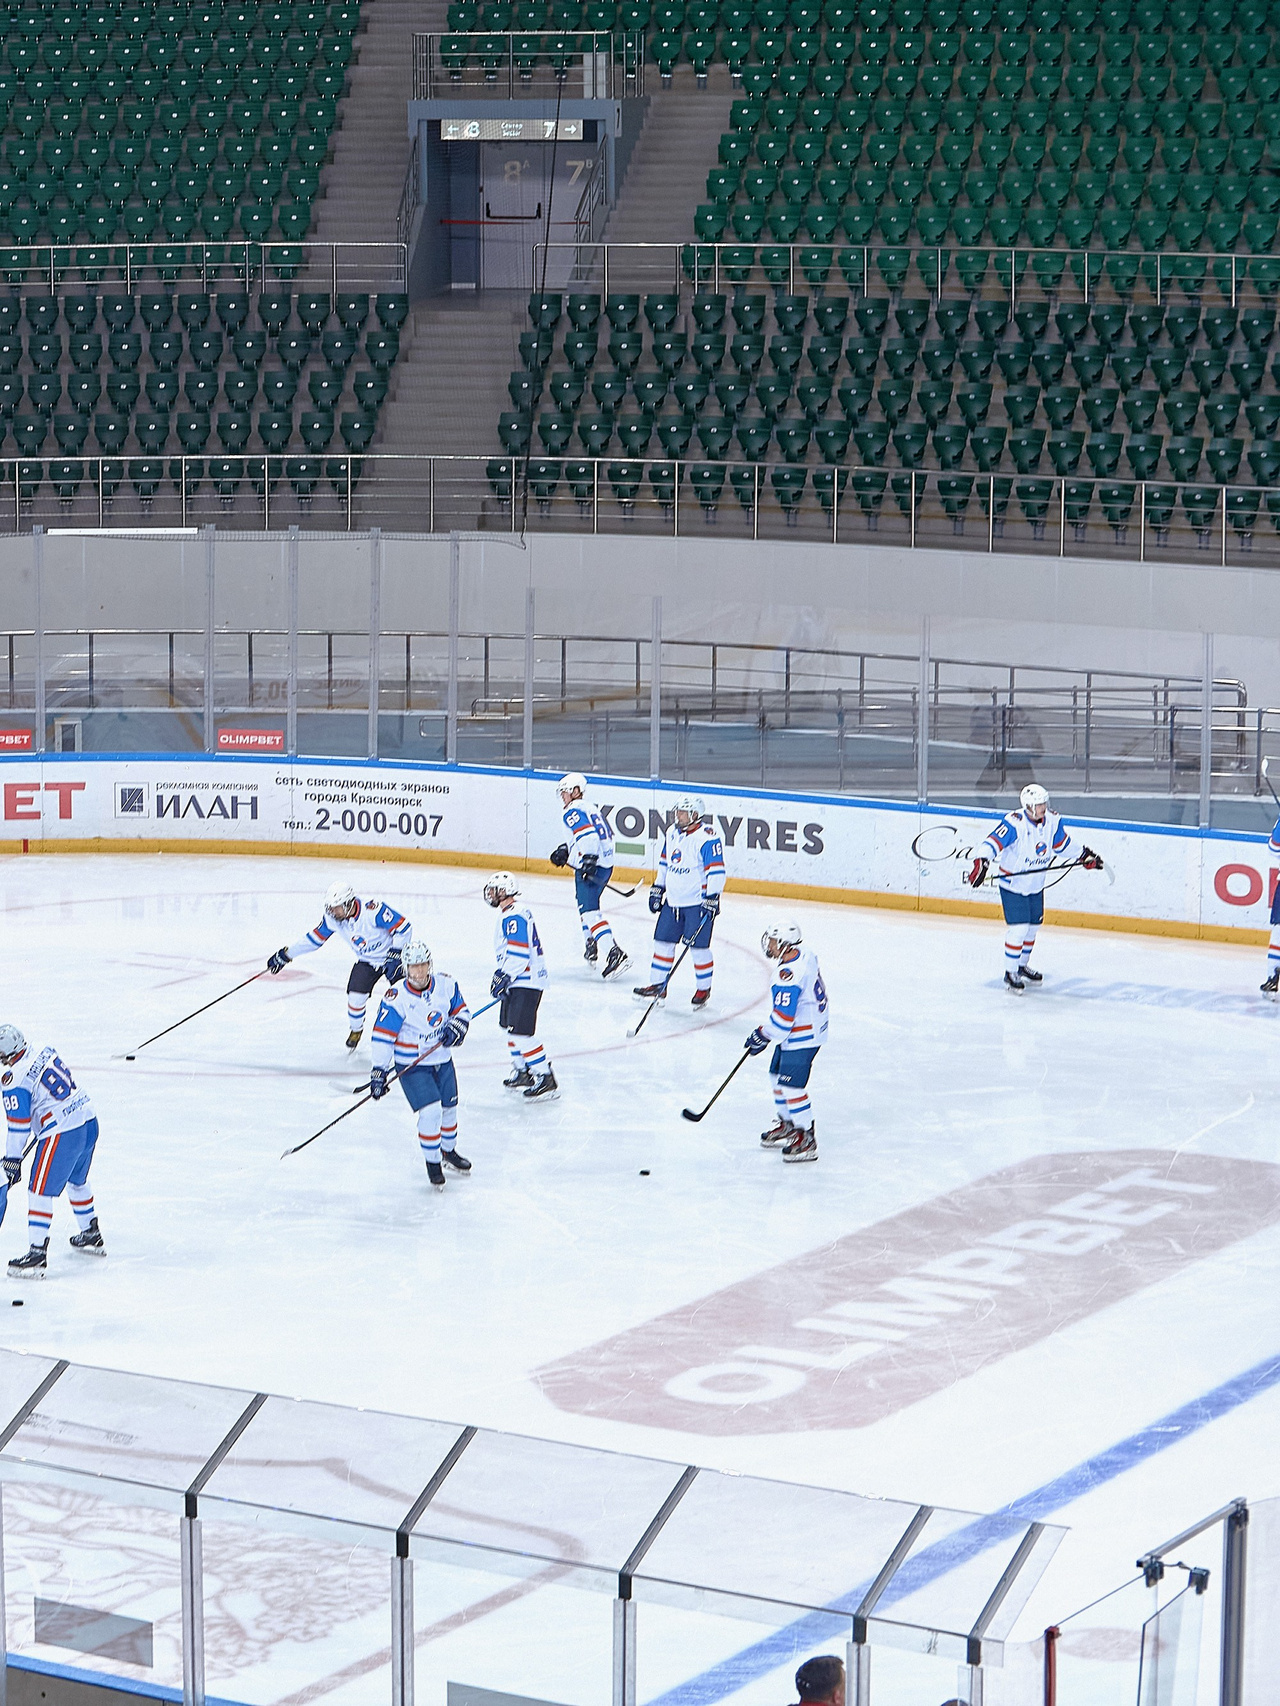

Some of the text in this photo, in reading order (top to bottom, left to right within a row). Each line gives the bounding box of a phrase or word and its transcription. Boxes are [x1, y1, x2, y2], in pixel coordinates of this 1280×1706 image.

[219, 734, 283, 746] OLIMPBET
[275, 776, 450, 795] сеть светодиодных экранов
[156, 794, 258, 820] ИЛАН
[304, 792, 423, 808] города Красноярск
[315, 807, 444, 838] 2-000-007
[663, 1168, 1220, 1405] OLIMPBET
